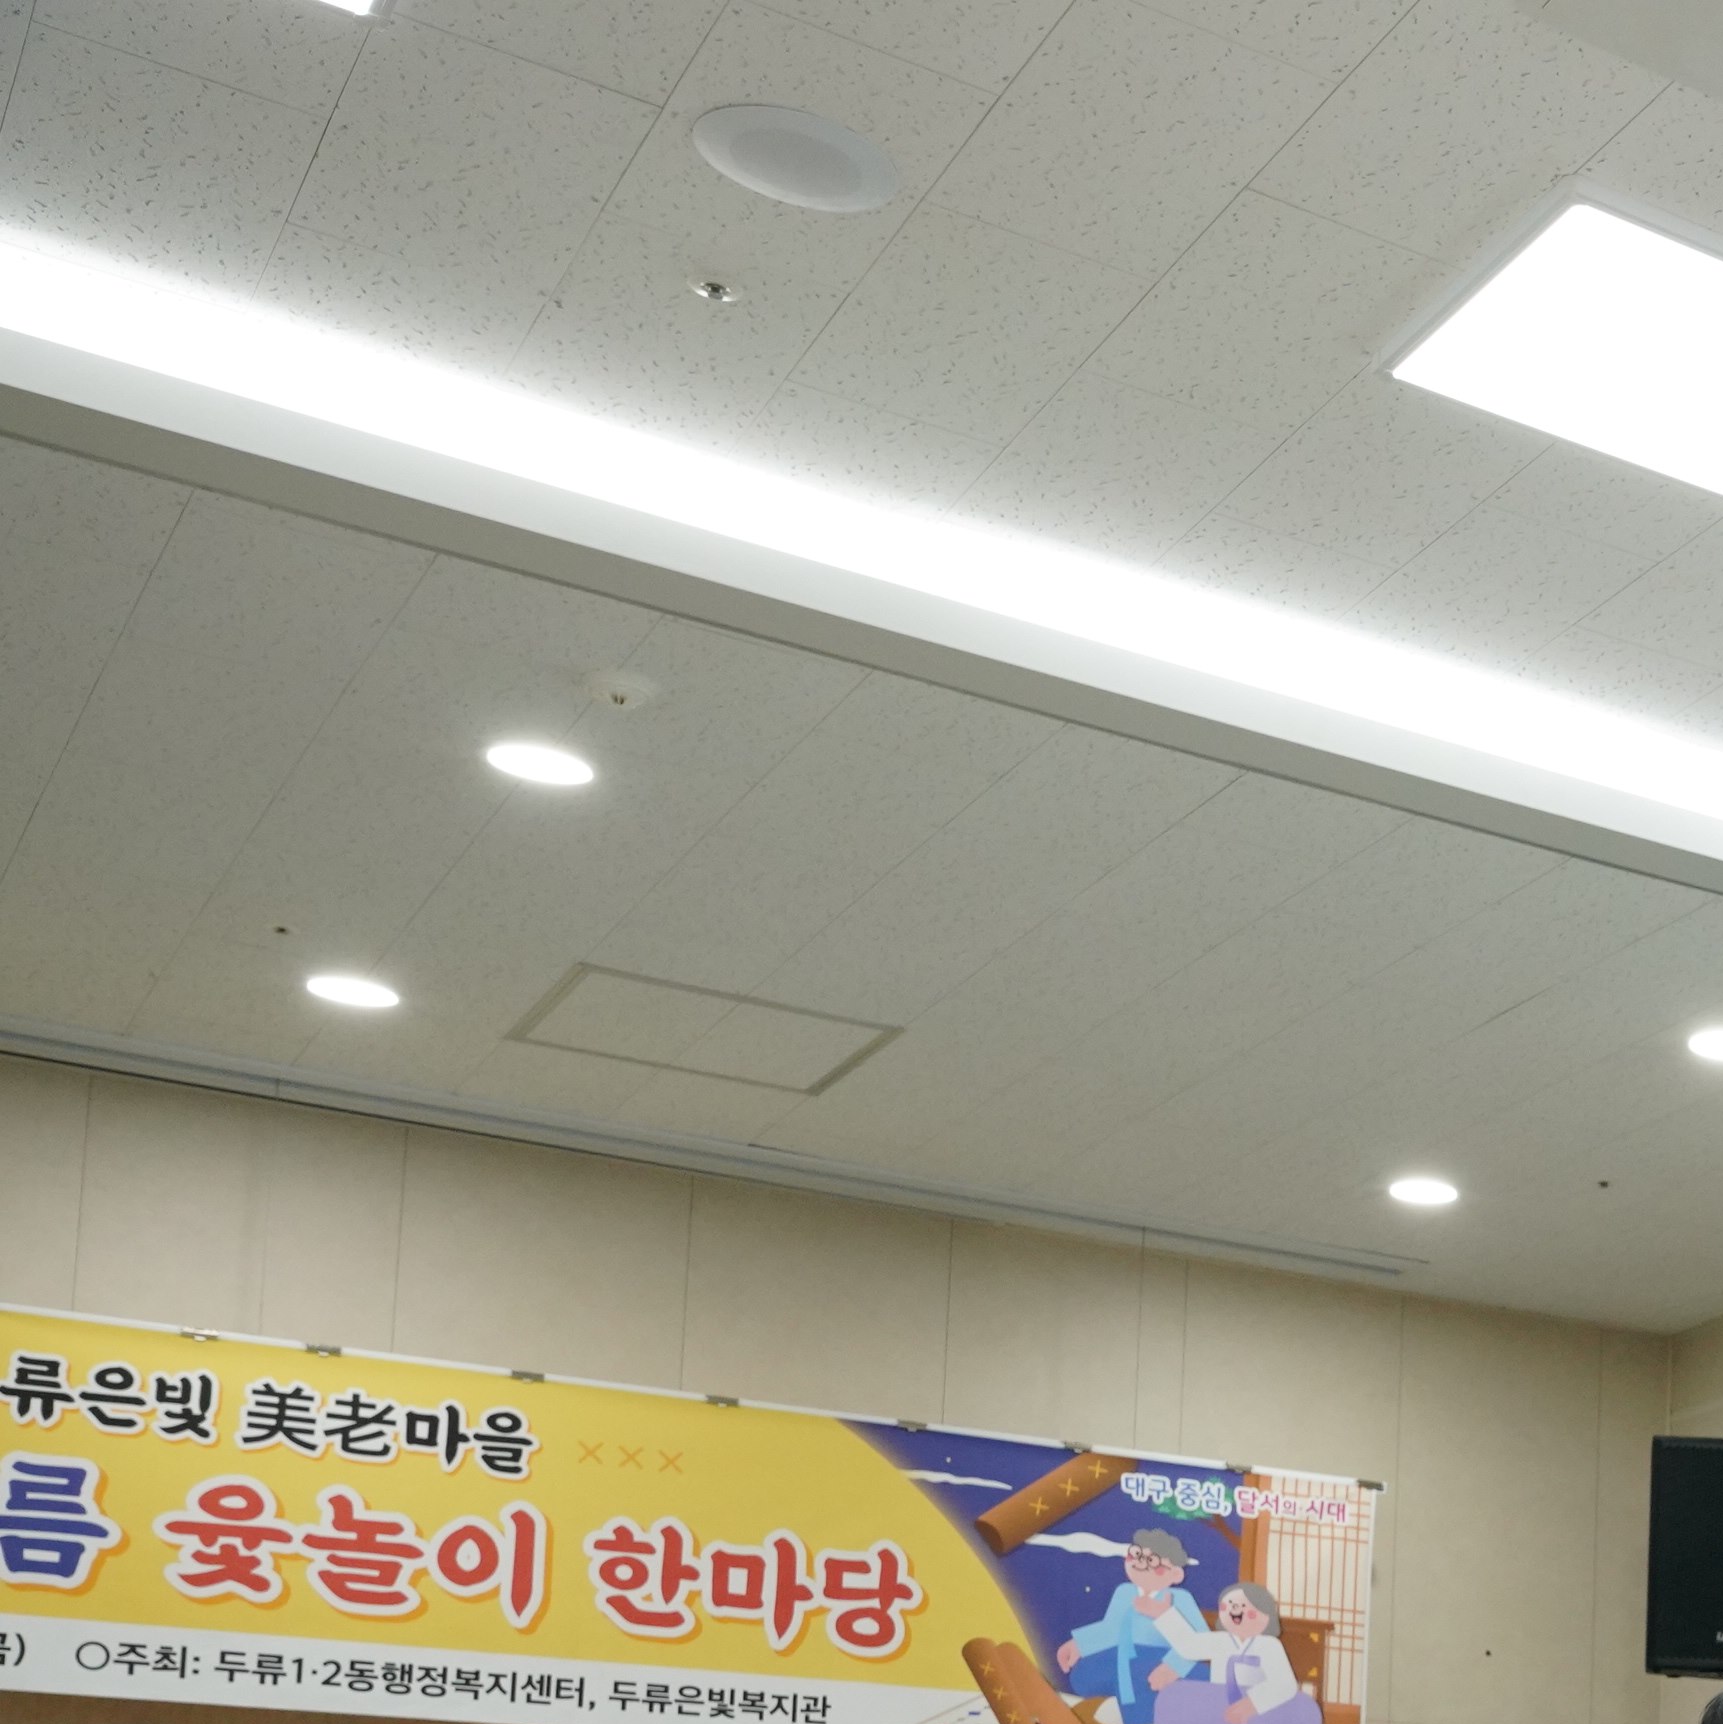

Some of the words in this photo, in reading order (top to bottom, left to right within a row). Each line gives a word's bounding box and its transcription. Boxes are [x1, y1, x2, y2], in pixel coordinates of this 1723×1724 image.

[0, 1355, 213, 1440] 류은빛
[242, 1383, 534, 1474] 美老마을
[1124, 1475, 1169, 1500] 대구
[1178, 1483, 1229, 1513] 중심,
[1237, 1488, 1297, 1516] 달서의
[1306, 1500, 1347, 1523] 시대
[0, 1460, 109, 1578] 름
[165, 1484, 537, 1617] 윷놀이
[594, 1525, 913, 1649] 한마당
[609, 1681, 831, 1724] 두류은빛복지관
